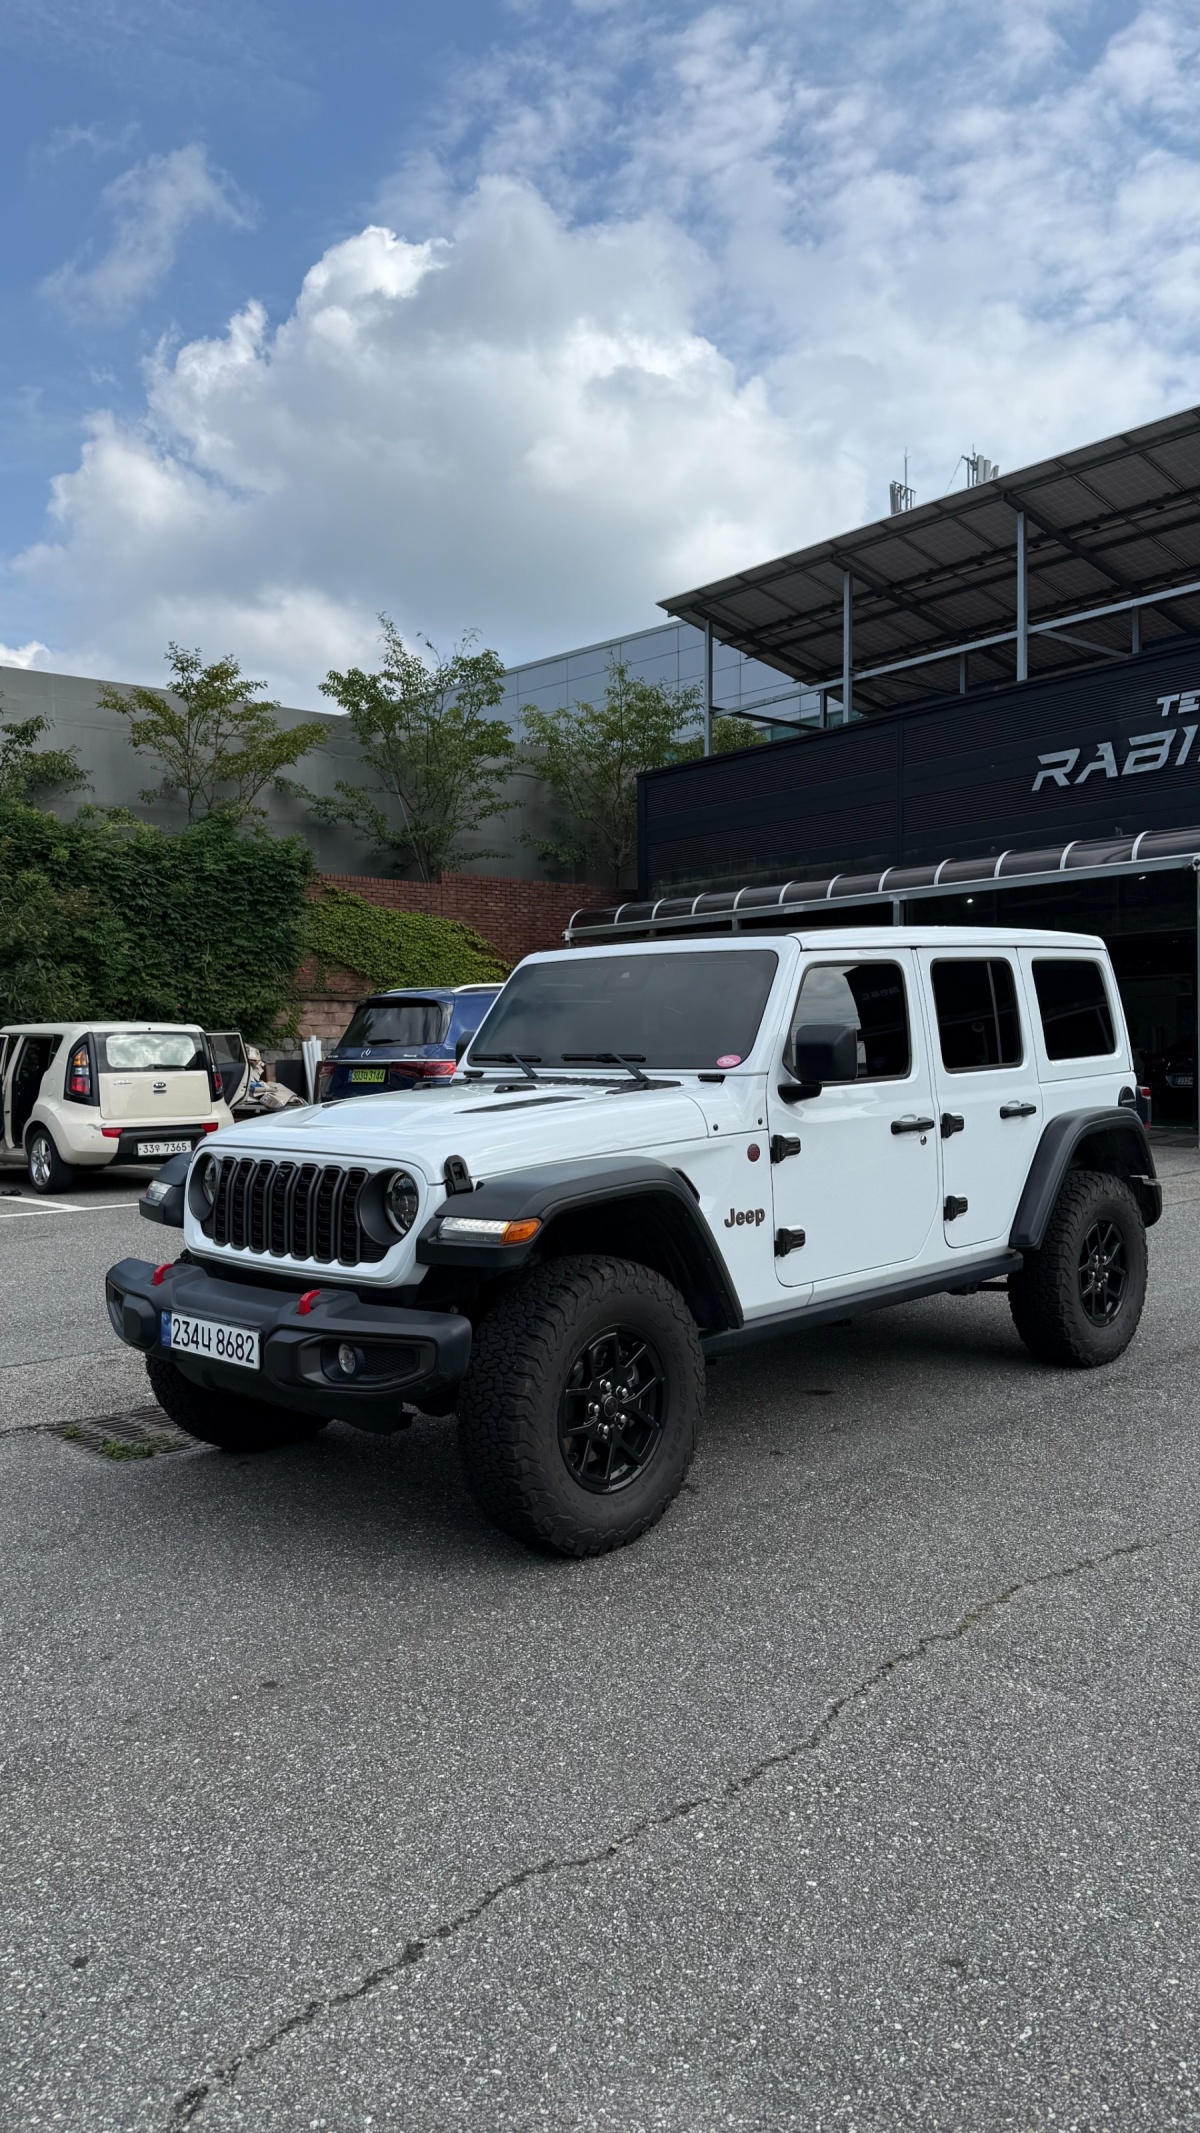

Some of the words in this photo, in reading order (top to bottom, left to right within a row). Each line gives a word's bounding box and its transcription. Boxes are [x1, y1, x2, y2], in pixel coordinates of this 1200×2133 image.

[1031, 724, 1200, 792] RABI
[142, 1144, 161, 1154] 33우
[164, 1142, 187, 1152] 7365
[724, 1208, 765, 1228] Jeep
[172, 1318, 212, 1352] 234나
[216, 1328, 255, 1364] 8682
